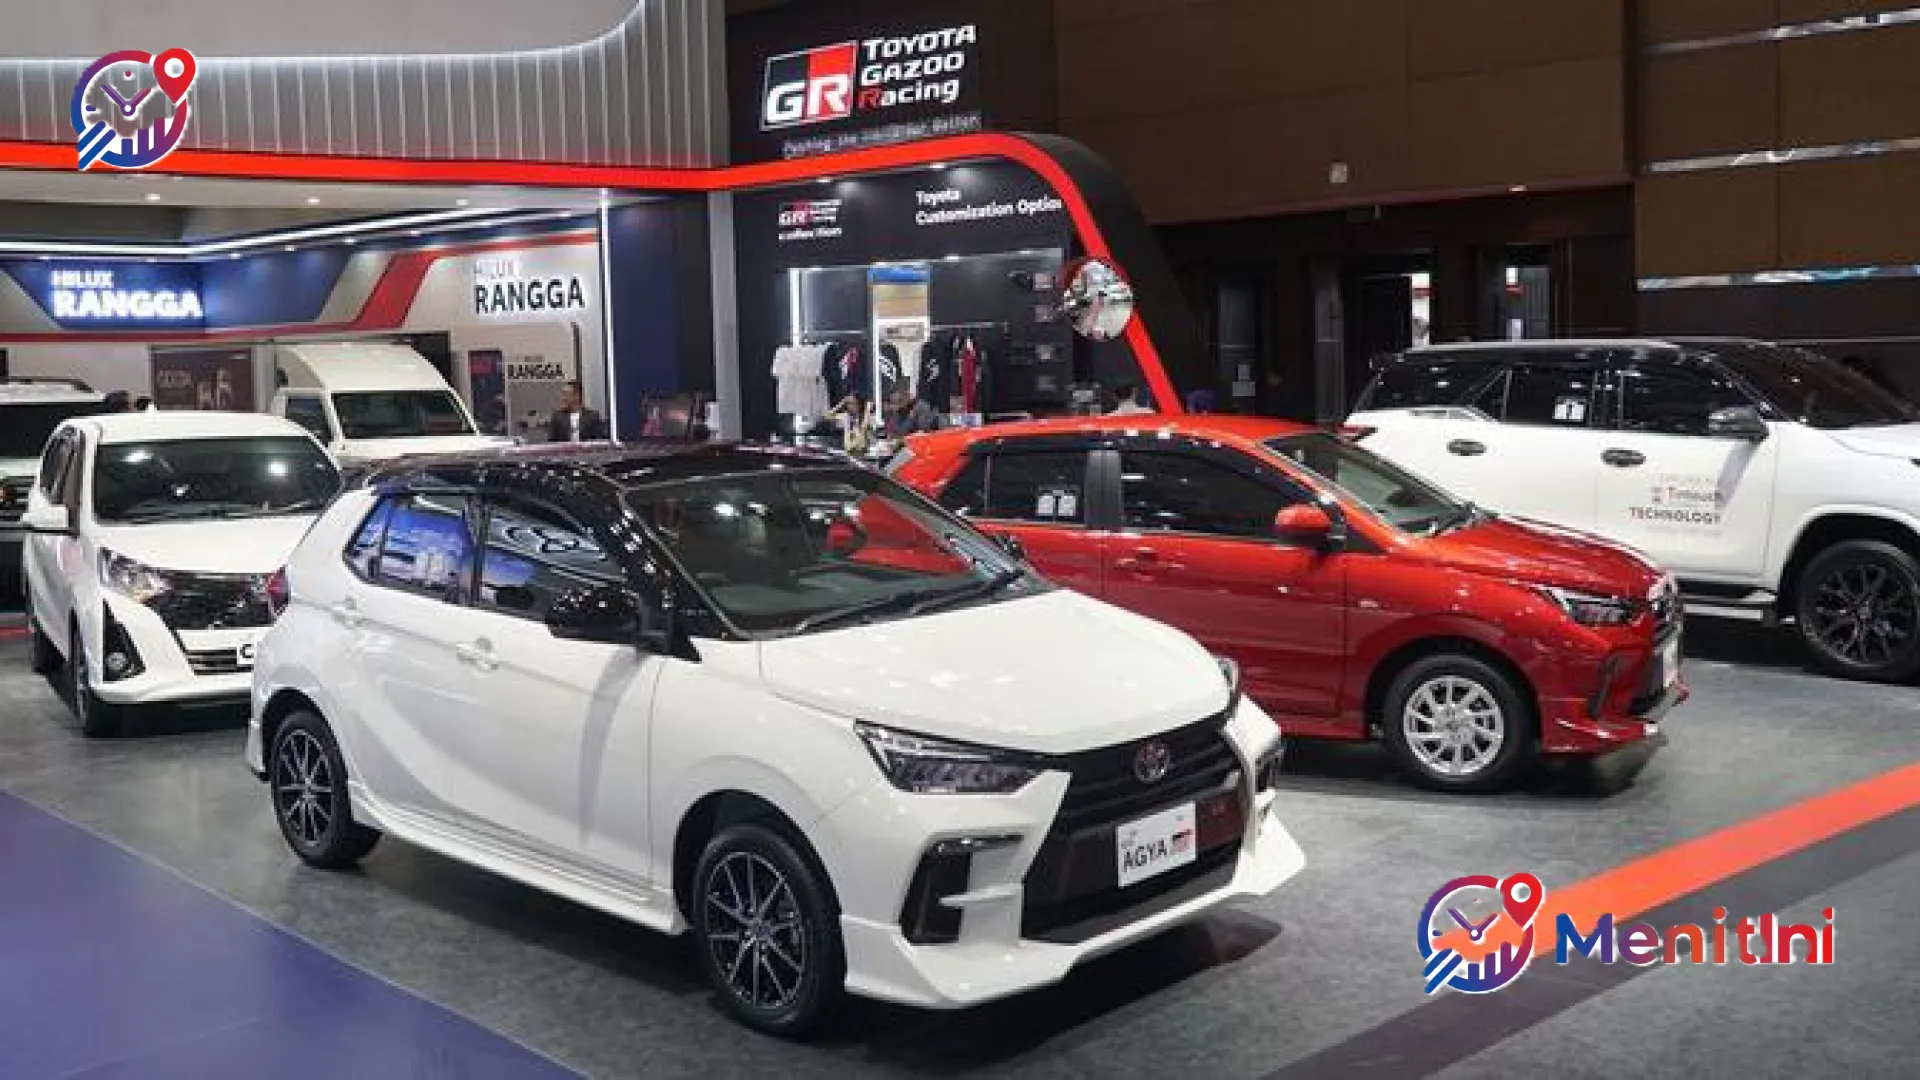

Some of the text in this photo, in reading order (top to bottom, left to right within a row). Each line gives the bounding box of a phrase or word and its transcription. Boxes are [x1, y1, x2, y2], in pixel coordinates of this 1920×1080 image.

[861, 24, 977, 60] TOYOTA
[860, 51, 965, 86] GAZOO
[766, 73, 852, 120] GR
[857, 79, 960, 108] Racing
[915, 188, 960, 205] Toyota
[915, 200, 1014, 225] Customization
[51, 269, 114, 288] HILUX
[52, 289, 204, 319] RANGGA
[474, 275, 586, 314] RANGGA
[1629, 506, 1721, 525] TECHNOLOGY
[1122, 839, 1168, 873] AGYA
